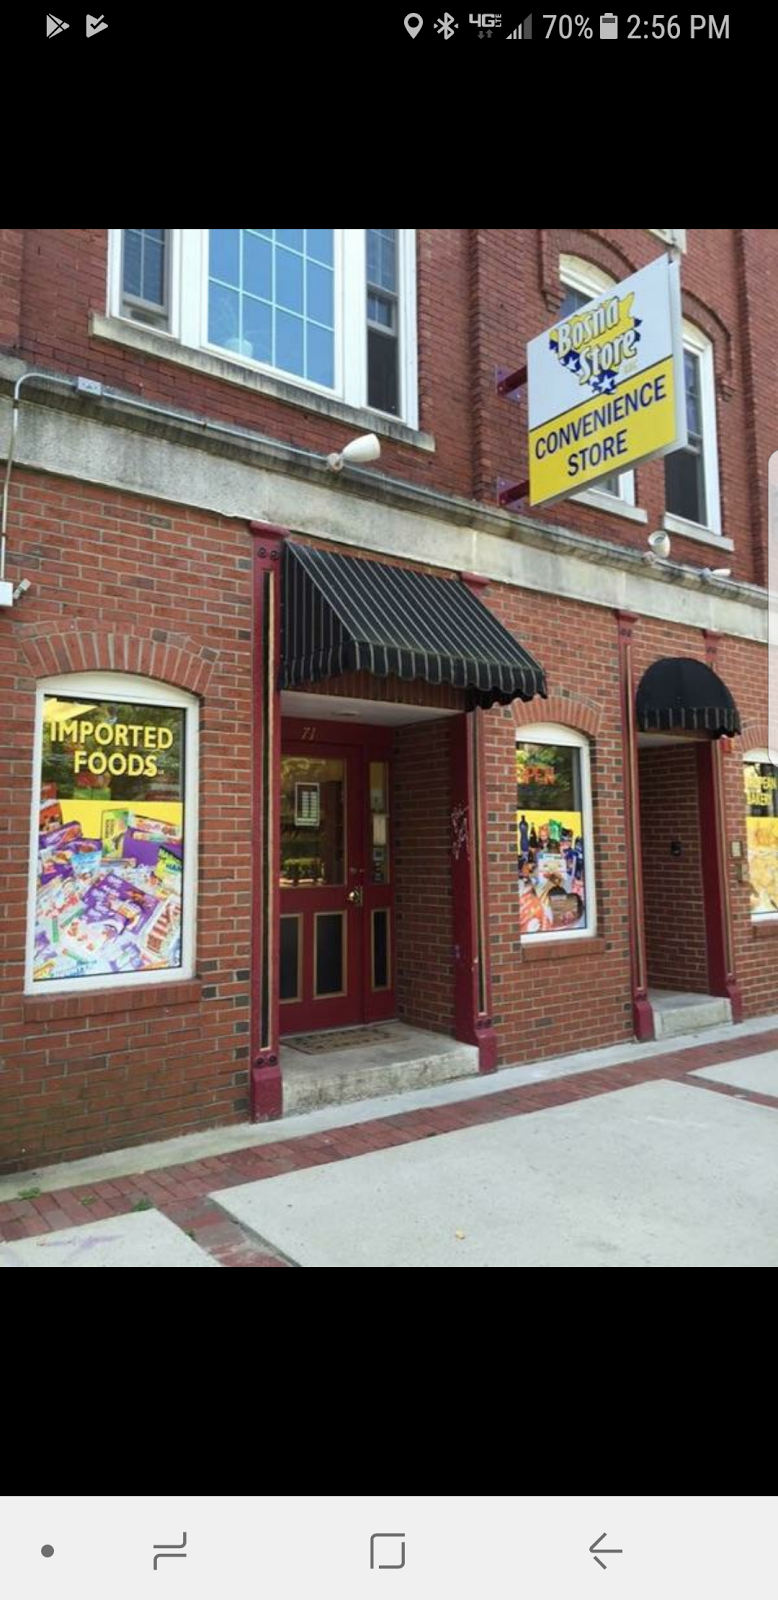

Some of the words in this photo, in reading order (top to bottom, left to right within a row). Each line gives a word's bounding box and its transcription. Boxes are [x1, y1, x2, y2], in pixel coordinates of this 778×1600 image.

[557, 296, 621, 359] Bosna
[579, 328, 638, 386] Store
[534, 374, 667, 460] CONVENIENCE
[566, 429, 629, 478] STORE
[50, 719, 174, 750] IMPORTED
[73, 750, 158, 778] FOODS
